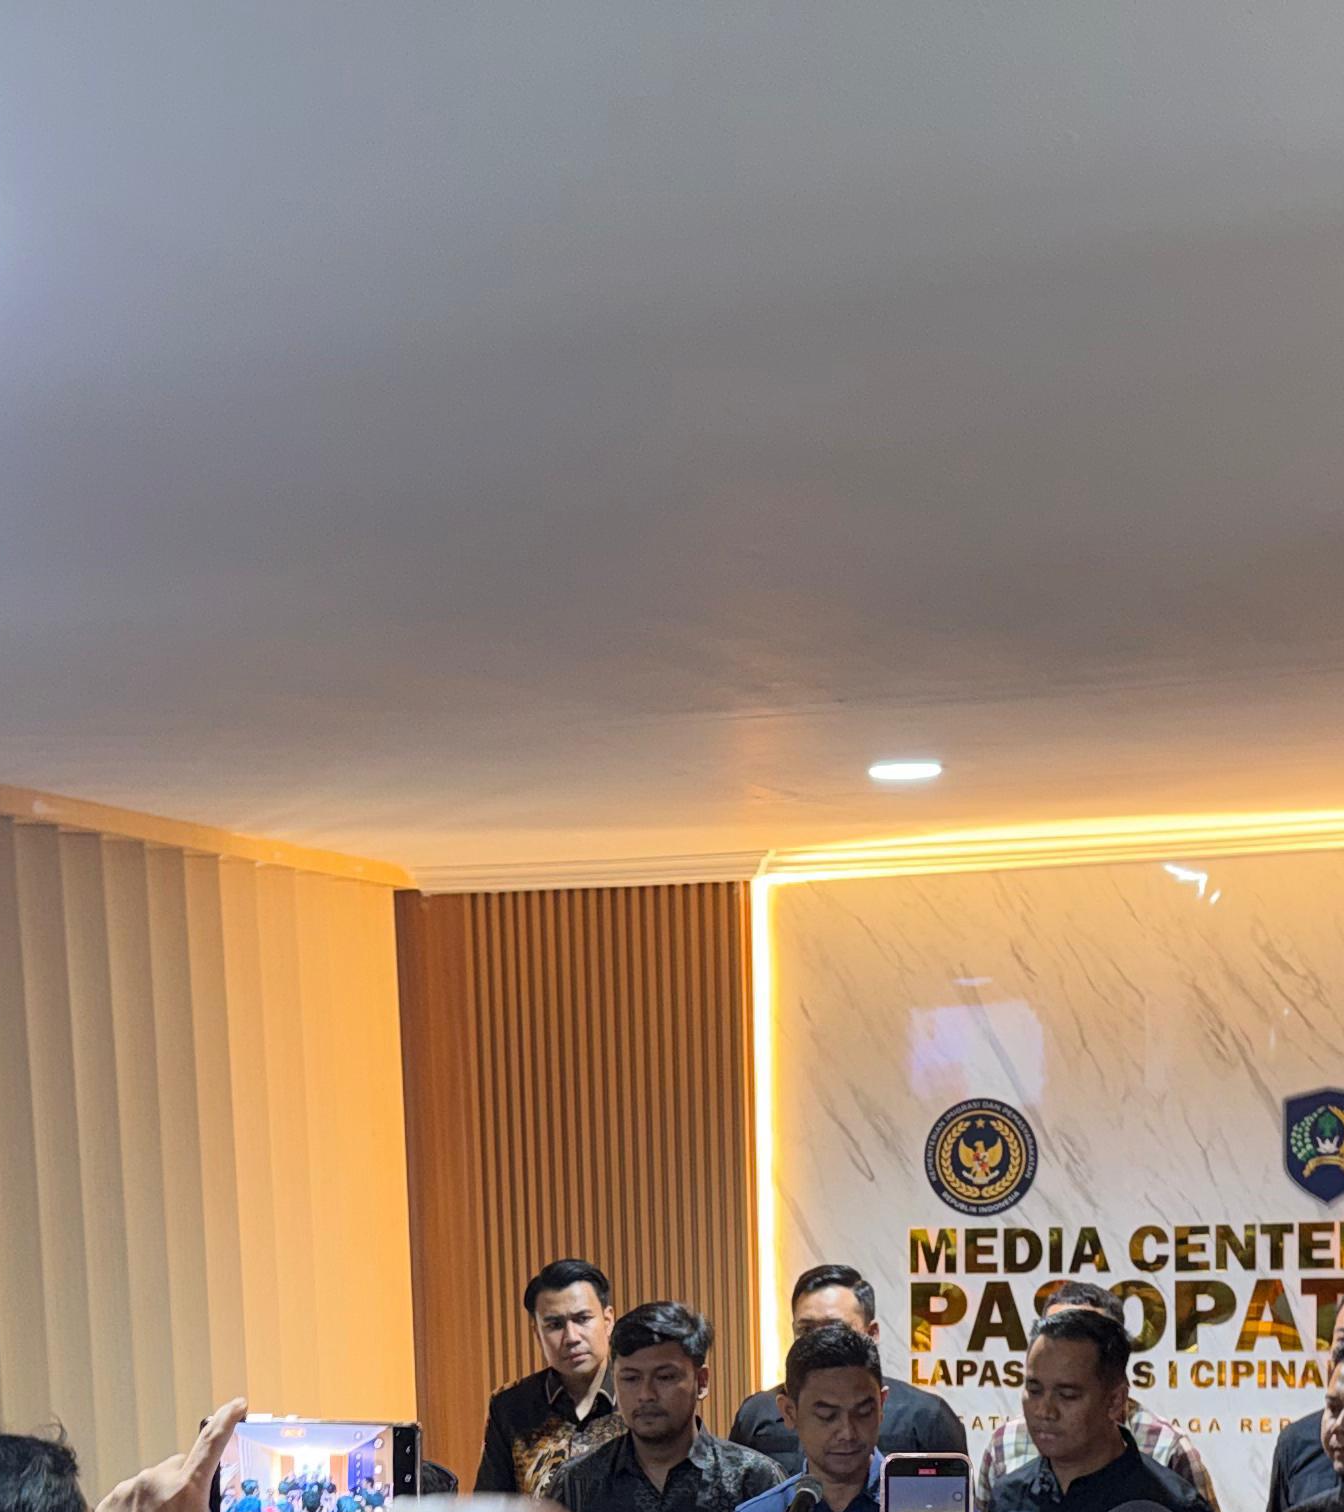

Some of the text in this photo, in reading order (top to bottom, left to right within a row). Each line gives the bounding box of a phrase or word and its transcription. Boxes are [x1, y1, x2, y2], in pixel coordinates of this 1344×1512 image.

[909, 1227, 1110, 1274] MEDIA
[911, 1360, 1024, 1387] LAPAS
[1190, 1359, 1336, 1389] CIPINA
